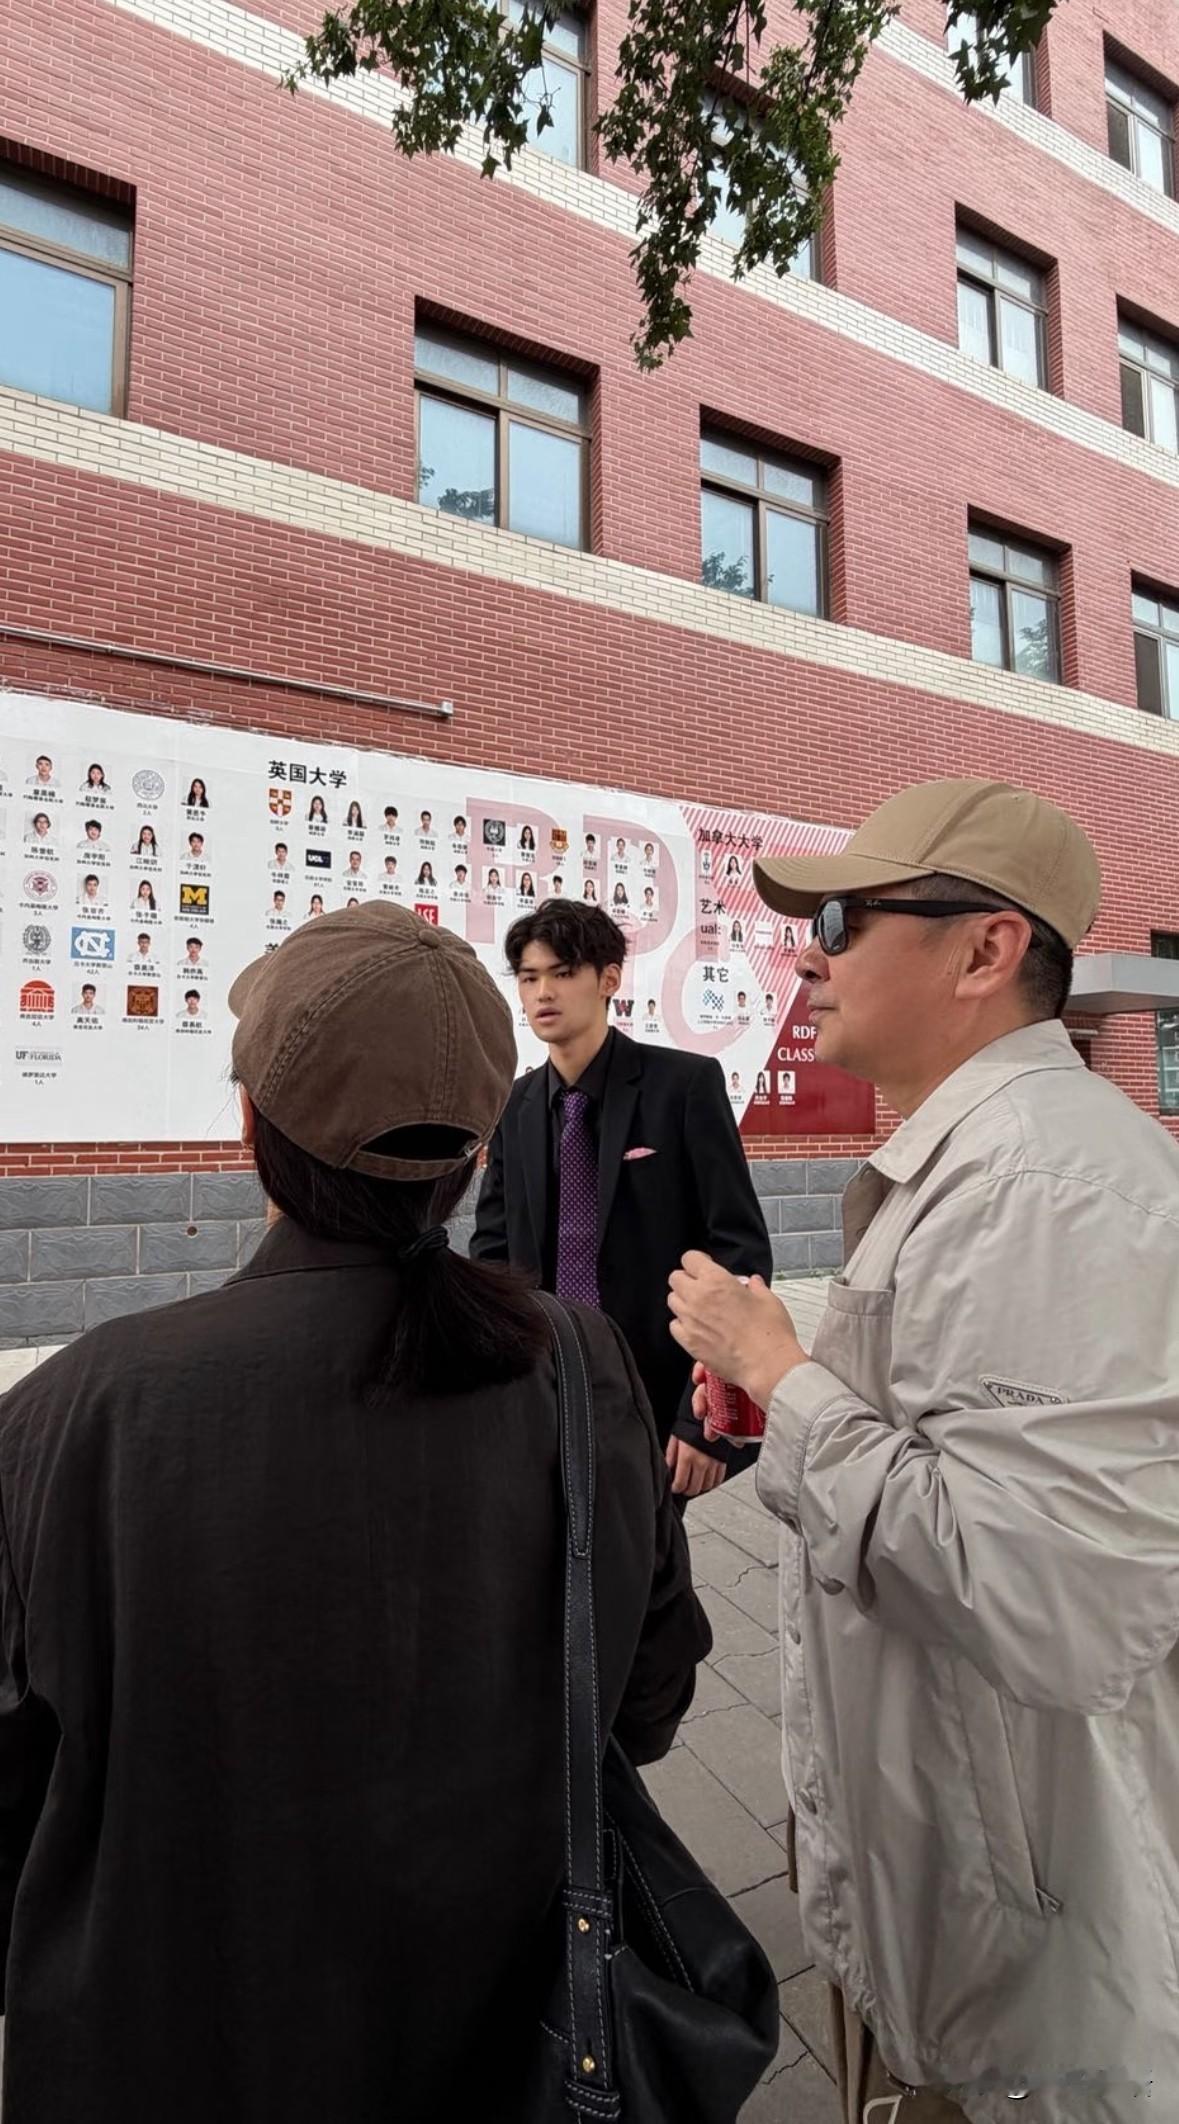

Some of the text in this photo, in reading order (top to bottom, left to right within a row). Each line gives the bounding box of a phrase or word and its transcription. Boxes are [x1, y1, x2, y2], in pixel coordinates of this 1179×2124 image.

[268, 759, 347, 789] 英国大学
[698, 827, 764, 851] 加拿大大学
[307, 854, 324, 863] UCL
[181, 885, 208, 905] M
[699, 898, 727, 915] 艺术
[700, 923, 721, 935] ual:
[702, 965, 729, 983] 其它
[612, 998, 635, 1017] W
[777, 1047, 815, 1062] CLASS
[997, 1386, 1044, 1405] PRADA
